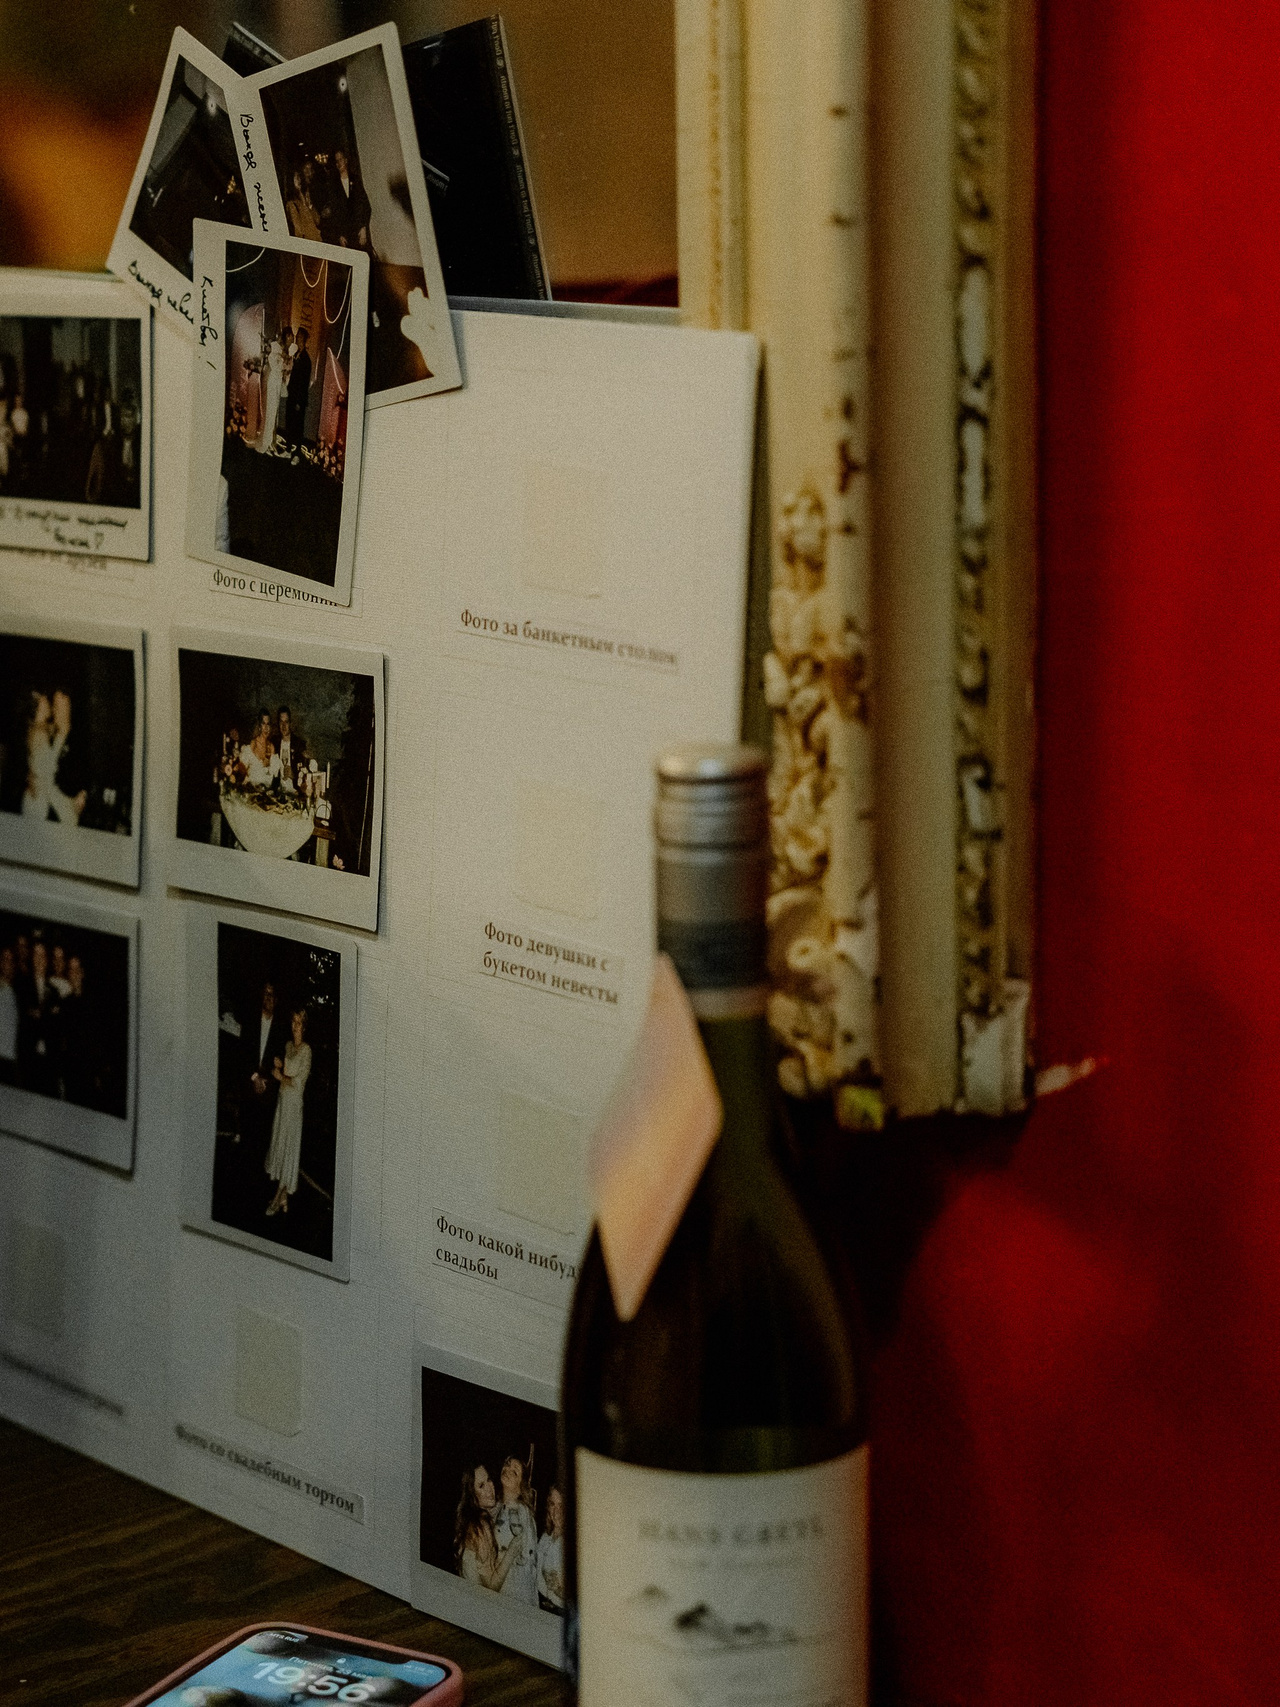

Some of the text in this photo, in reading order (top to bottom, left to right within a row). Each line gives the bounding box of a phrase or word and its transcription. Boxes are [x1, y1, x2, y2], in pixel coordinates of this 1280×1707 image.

[213, 569, 246, 590] Фото
[249, 580, 256, 592] с
[460, 608, 499, 632] Фото
[503, 621, 518, 636] за
[523, 620, 614, 655] банкетным
[484, 922, 608, 972] Фото девушки с
[483, 951, 619, 1004] букетом невесты
[435, 1247, 499, 1280] свадьбы
[436, 1215, 580, 1280] Фото какой нибуд
[227, 1451, 302, 1490] свадебным
[304, 1482, 355, 1514] тортом
[252, 1661, 376, 1702] 19:56
